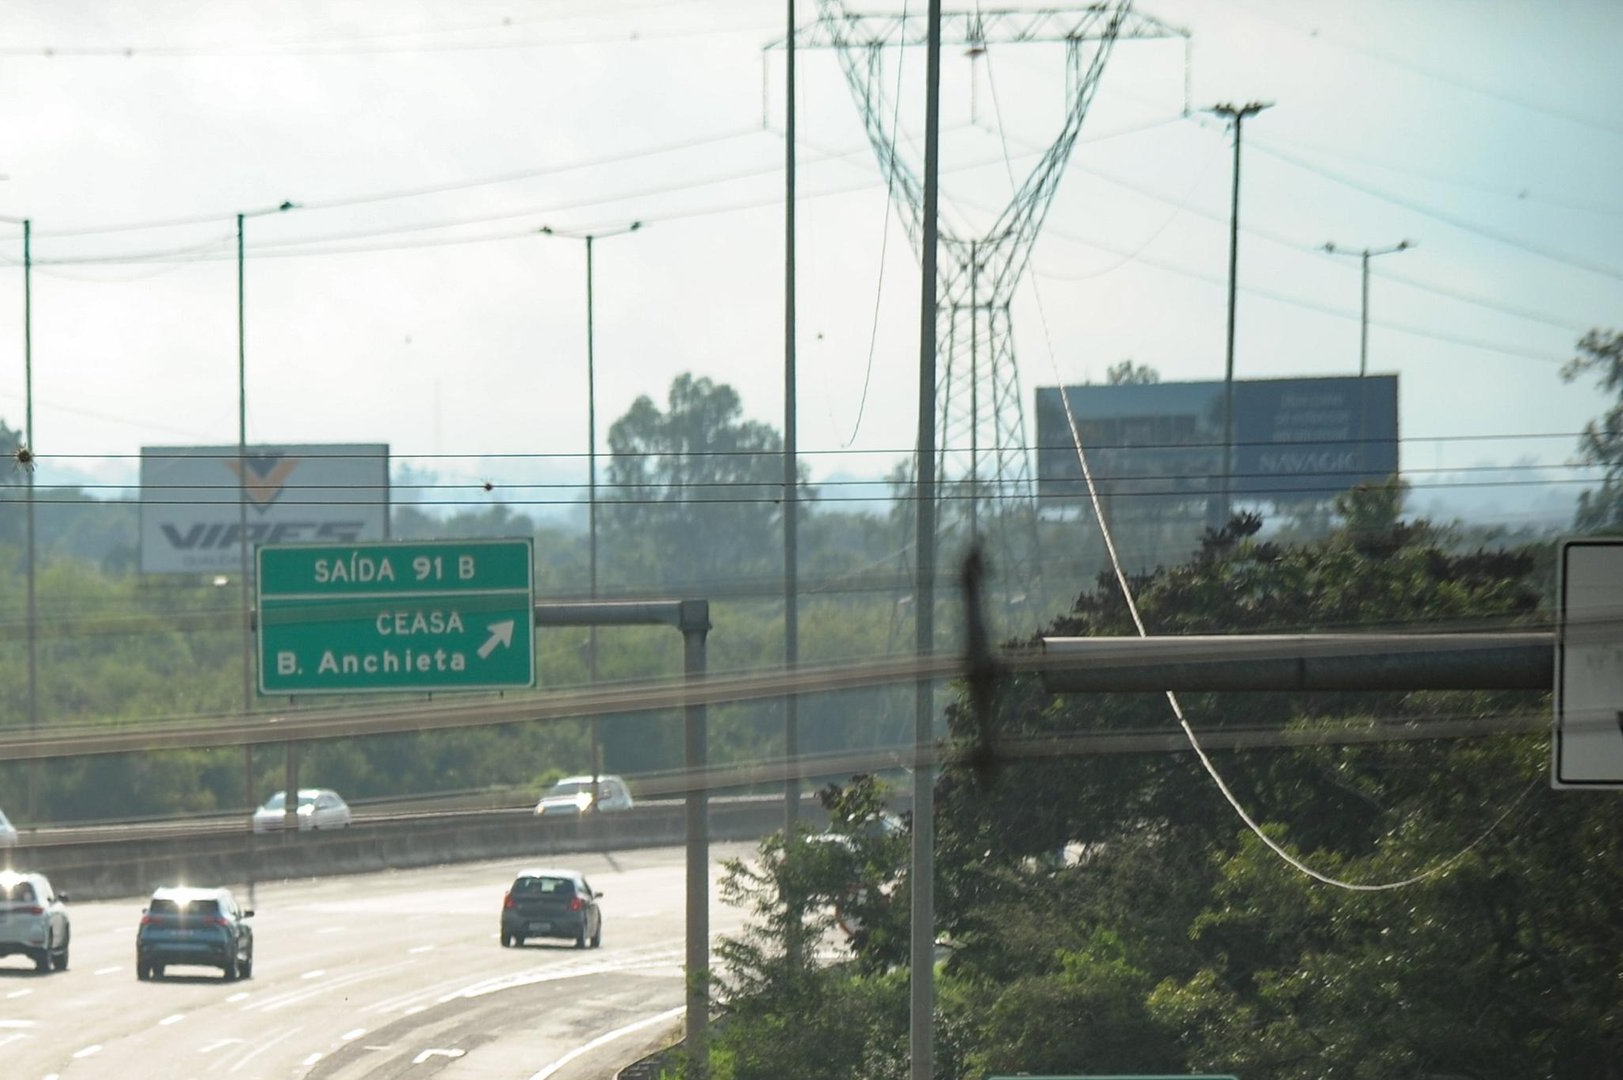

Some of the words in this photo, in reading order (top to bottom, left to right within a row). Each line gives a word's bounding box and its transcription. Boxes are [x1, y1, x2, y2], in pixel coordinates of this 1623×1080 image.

[314, 551, 395, 582] SAÍDA
[412, 556, 442, 581] 91
[458, 556, 475, 580] B
[376, 611, 464, 635] CEASA
[277, 651, 303, 675] B.
[317, 649, 466, 674] Anchieta
